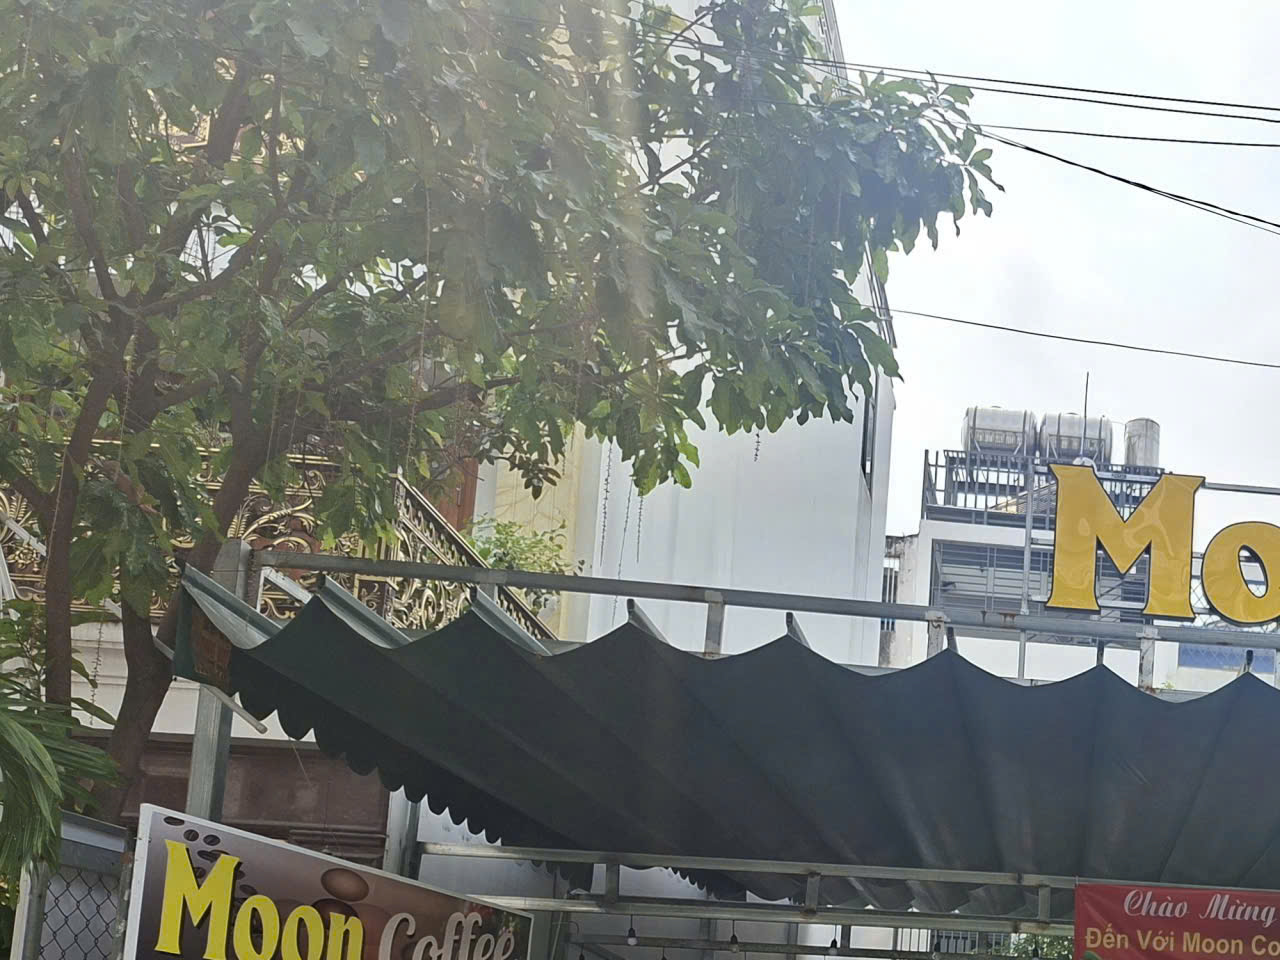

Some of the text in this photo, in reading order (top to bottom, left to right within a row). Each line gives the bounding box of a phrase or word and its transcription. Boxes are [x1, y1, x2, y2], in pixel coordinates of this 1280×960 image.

[1123, 888, 1189, 918] Chào
[1200, 893, 1278, 928] Mừng
[1085, 922, 1129, 949] Đến
[1136, 928, 1175, 953] Với
[1182, 933, 1243, 956] Moon
